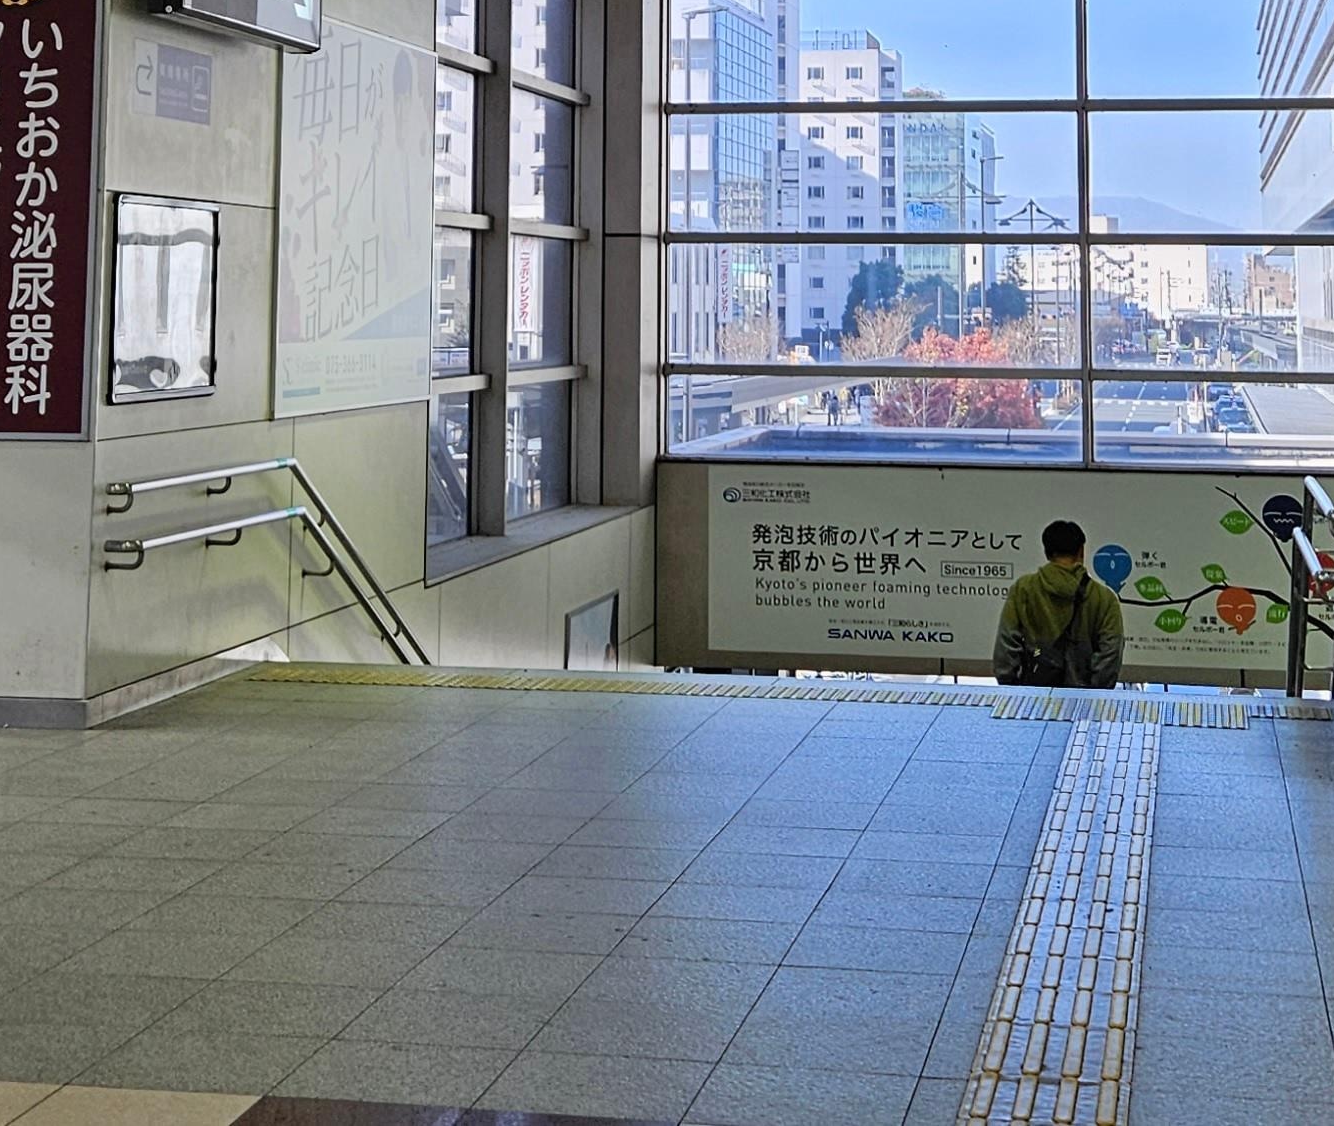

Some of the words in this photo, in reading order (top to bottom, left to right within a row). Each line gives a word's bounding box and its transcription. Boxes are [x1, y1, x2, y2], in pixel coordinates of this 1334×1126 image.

[3, 18, 63, 416] いちおか泌尿器科
[304, 233, 380, 342] 記念日
[752, 523, 1023, 550] 発泡技術のパイオニアとして
[752, 548, 927, 575] 京都から世界へ
[755, 577, 807, 593] Kyoto's
[813, 579, 867, 594] pioneer
[873, 580, 931, 597] foaming
[937, 582, 1010, 600] technolog
[755, 594, 812, 608] bubbles
[817, 595, 840, 609] the
[845, 597, 885, 610] world
[827, 628, 895, 641] SANWA
[902, 630, 954, 643] KAKO
